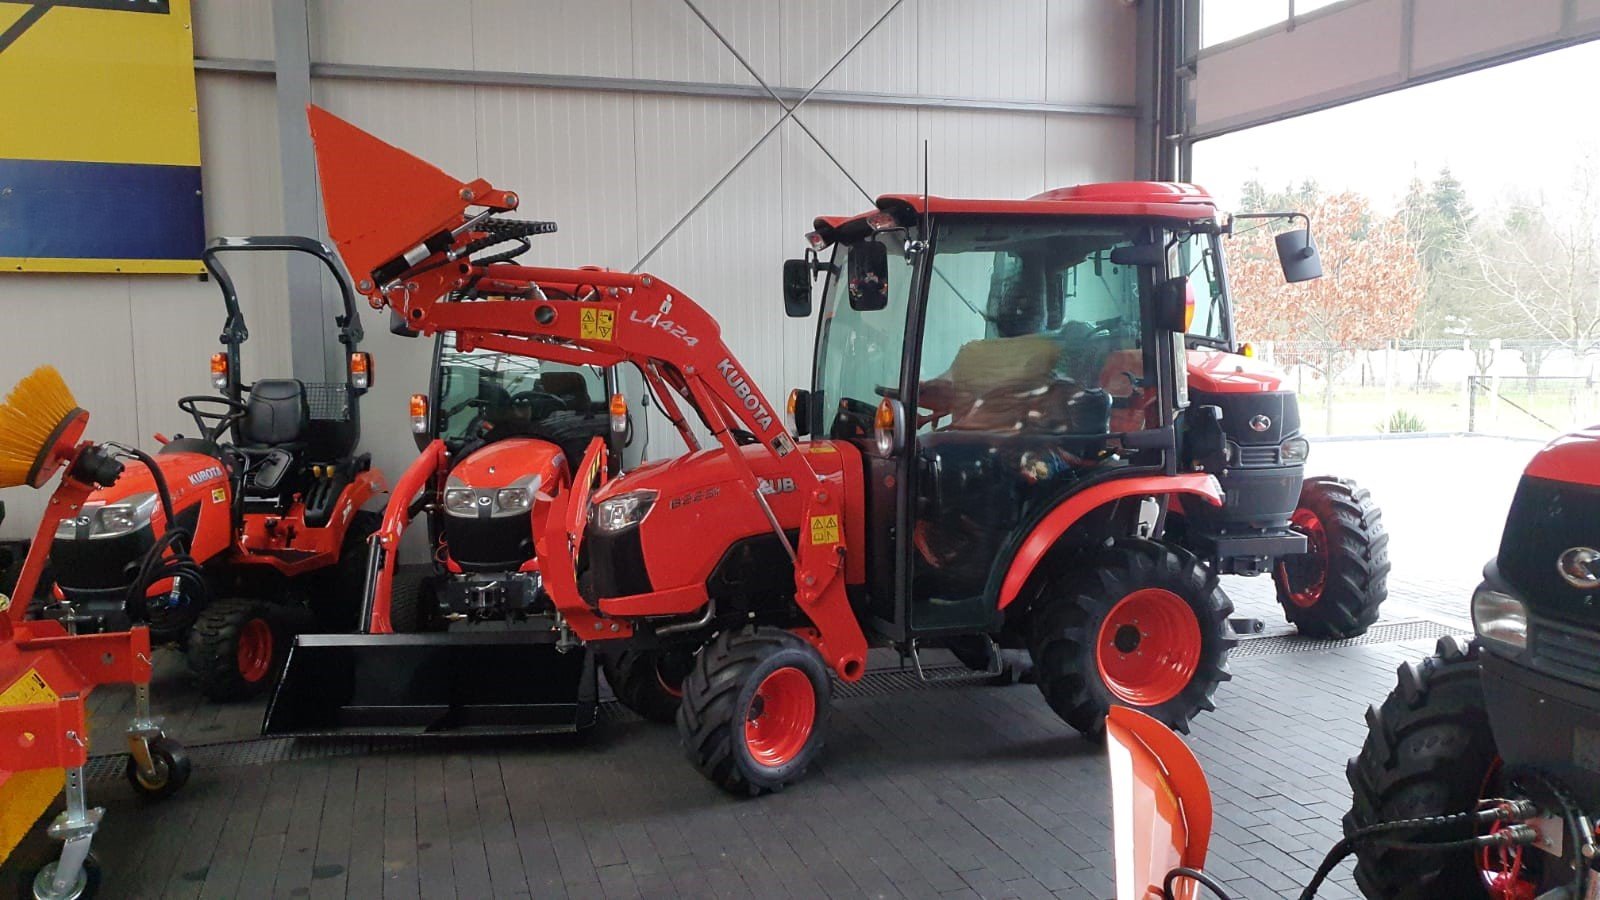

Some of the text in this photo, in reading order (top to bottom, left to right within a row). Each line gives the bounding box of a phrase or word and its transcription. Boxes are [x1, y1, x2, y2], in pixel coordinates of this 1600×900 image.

[630, 310, 699, 346] LA424
[717, 358, 773, 431] KUBOTA
[188, 466, 223, 486] KUBOTA
